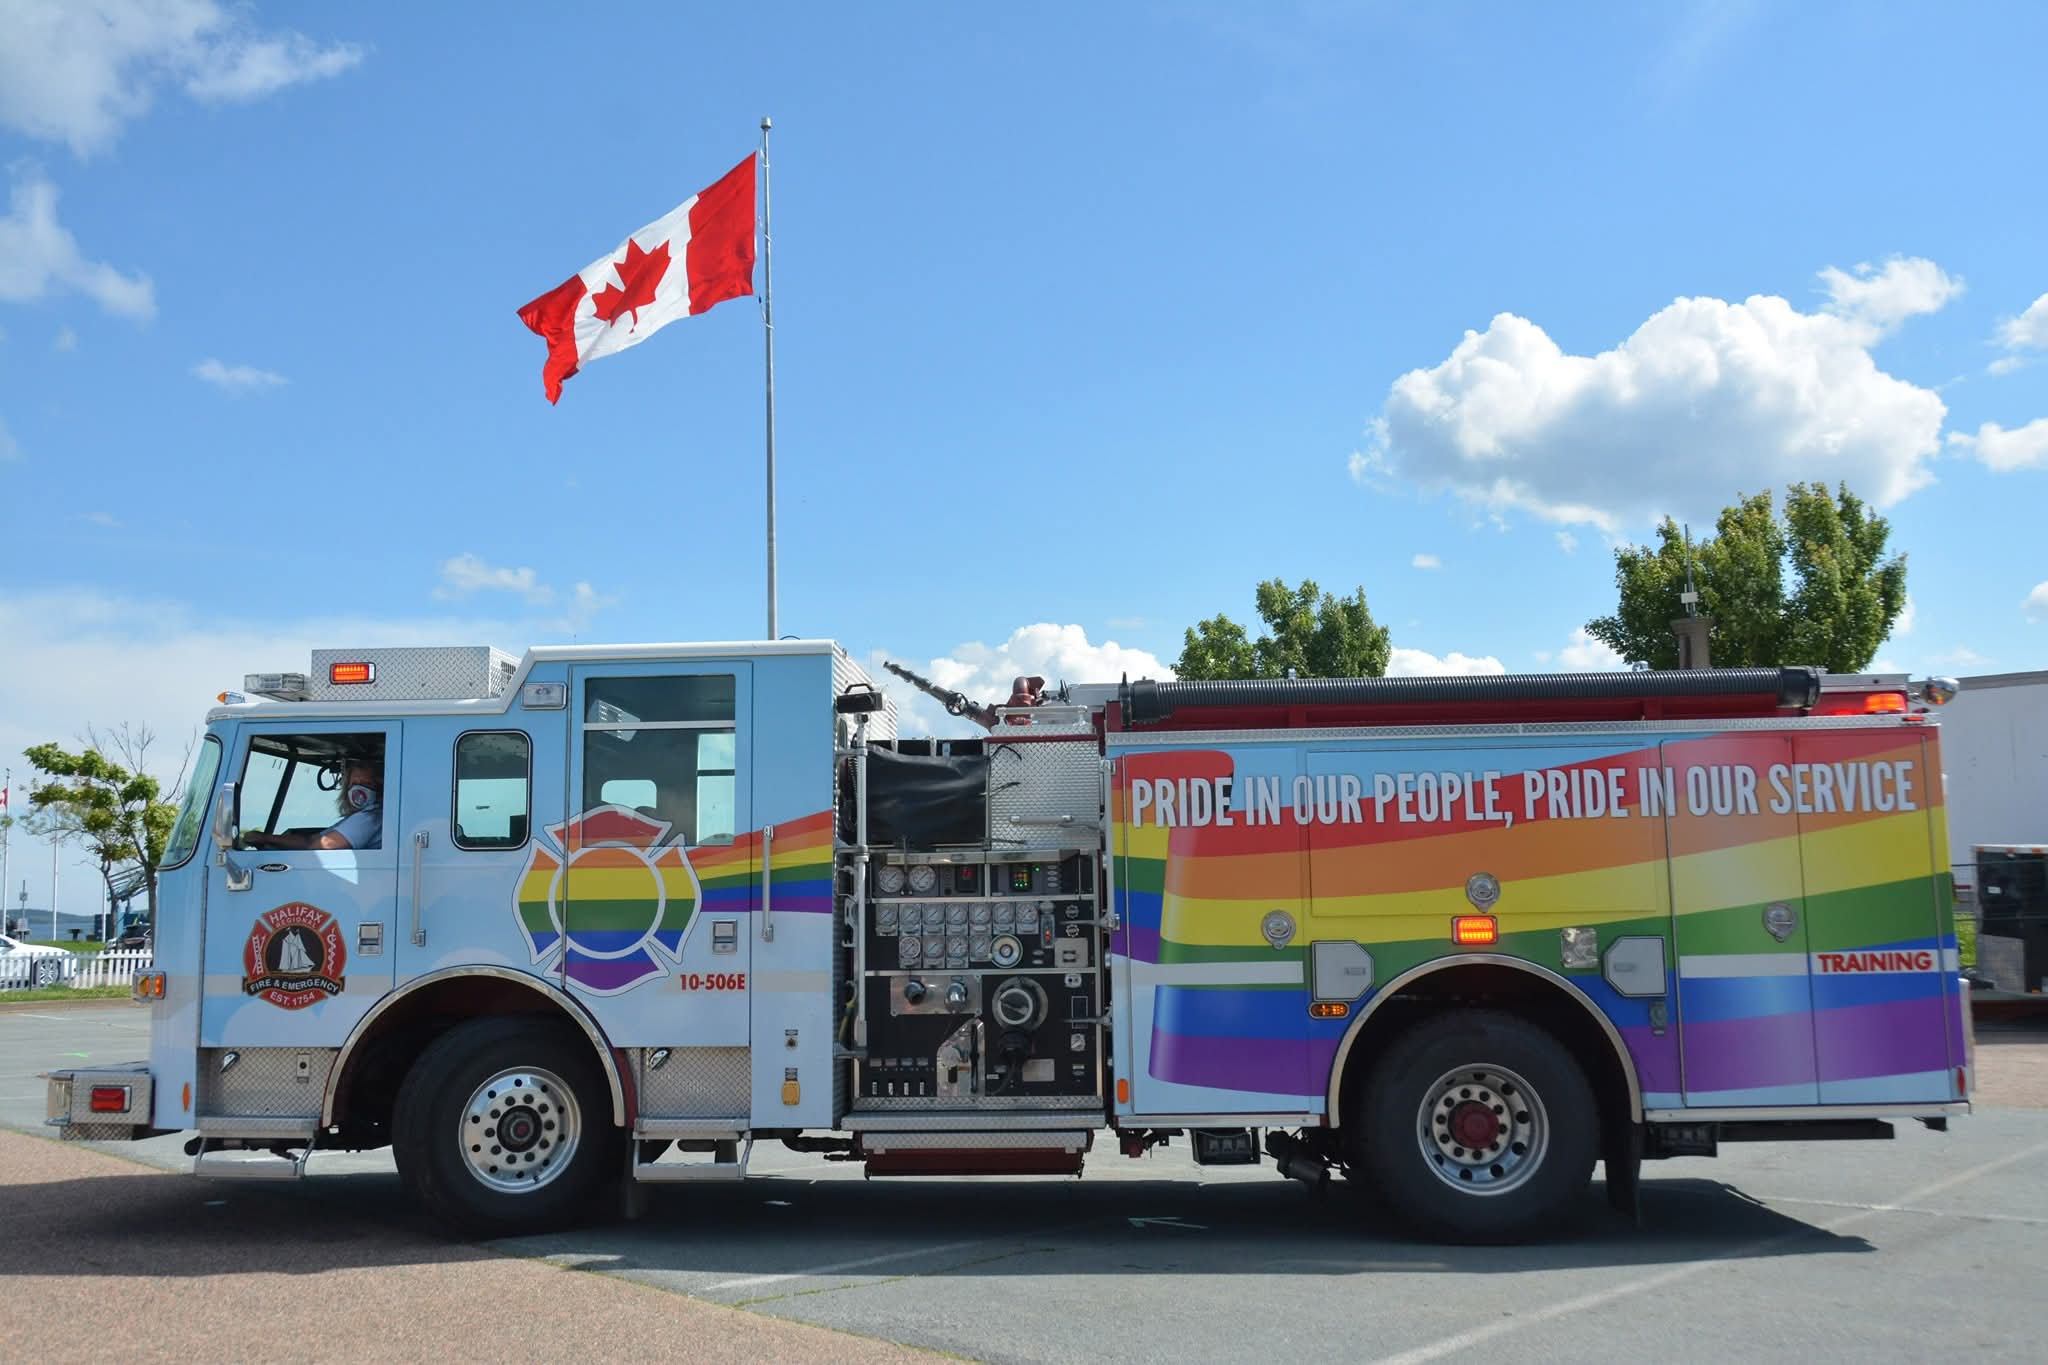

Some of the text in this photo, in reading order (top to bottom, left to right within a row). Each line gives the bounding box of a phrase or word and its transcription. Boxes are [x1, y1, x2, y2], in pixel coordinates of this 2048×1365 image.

[1132, 761, 1917, 828] PRIDE IN OUR PEOPLE, PRIDE IN OUR SERVICE
[269, 907, 323, 924] HALIFAX
[275, 917, 318, 929] REGIONAL
[1818, 952, 1932, 972] TRAINING
[250, 979, 339, 993] FIRE & EMERGENCY
[680, 973, 745, 990] 10-506E
